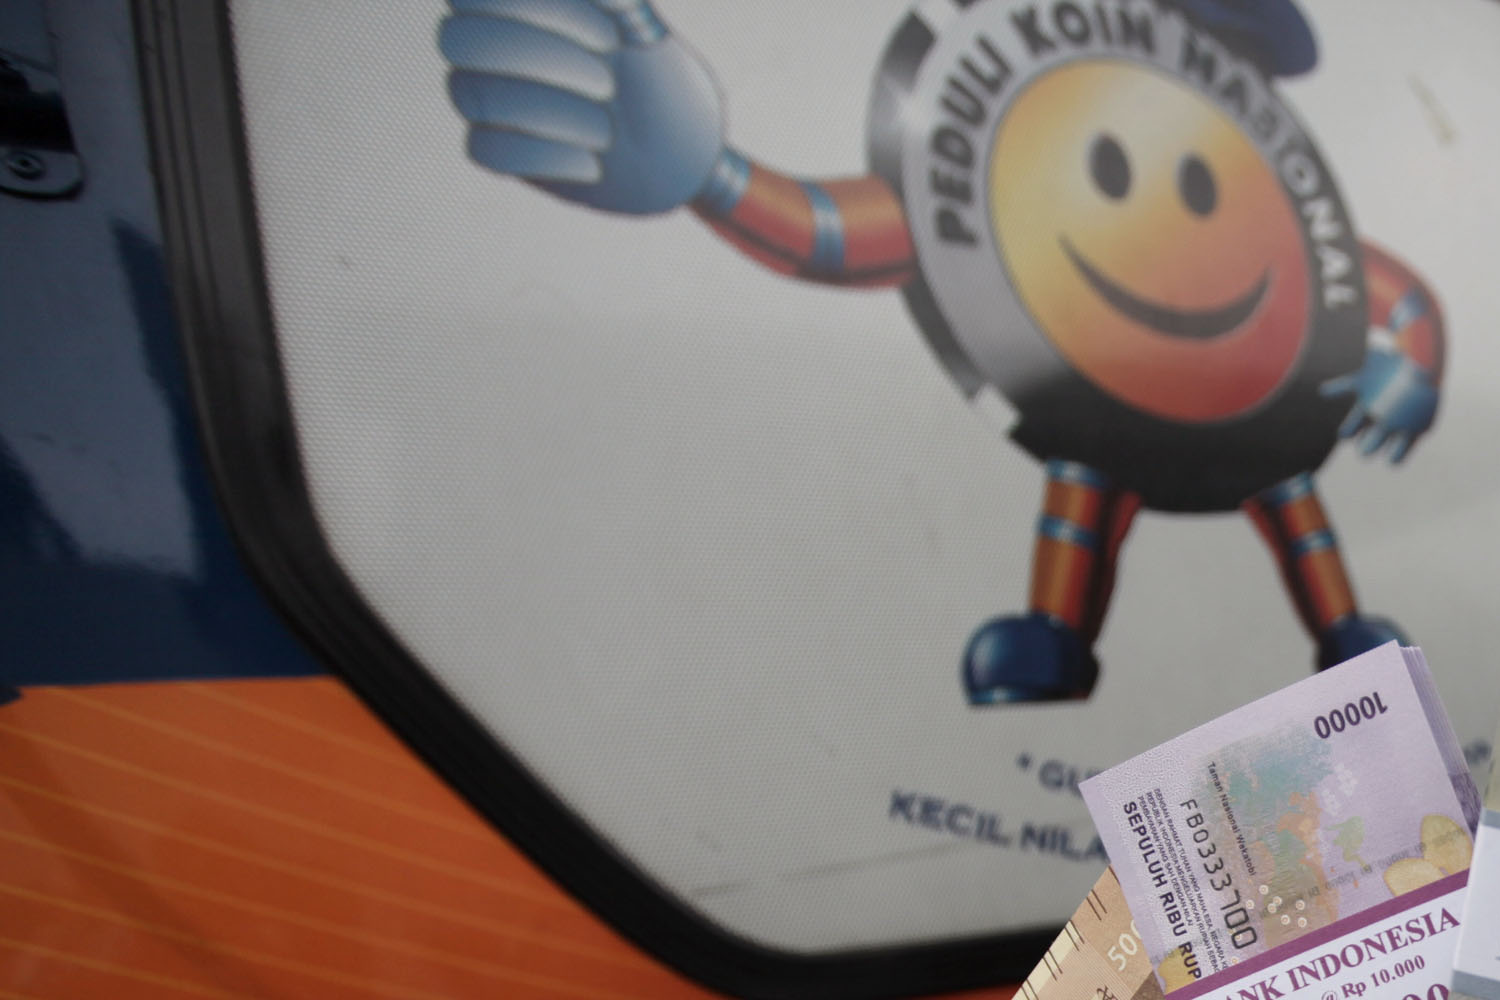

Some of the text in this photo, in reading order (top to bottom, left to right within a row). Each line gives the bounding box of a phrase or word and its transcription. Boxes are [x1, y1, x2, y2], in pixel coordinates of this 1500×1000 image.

[929, 35, 1014, 249] PEDULI
[1009, 0, 1159, 59] KOIN
[1309, 688, 1389, 741] 10000
[889, 787, 1012, 848] KECIL
[1205, 762, 1258, 877] Taman Nasional Wakatobi
[1120, 799, 1169, 889] SEPULUH
[1157, 890, 1188, 938] RIBU
[1283, 902, 1461, 993] INDONESIA
[1368, 952, 1427, 989] 10.000
